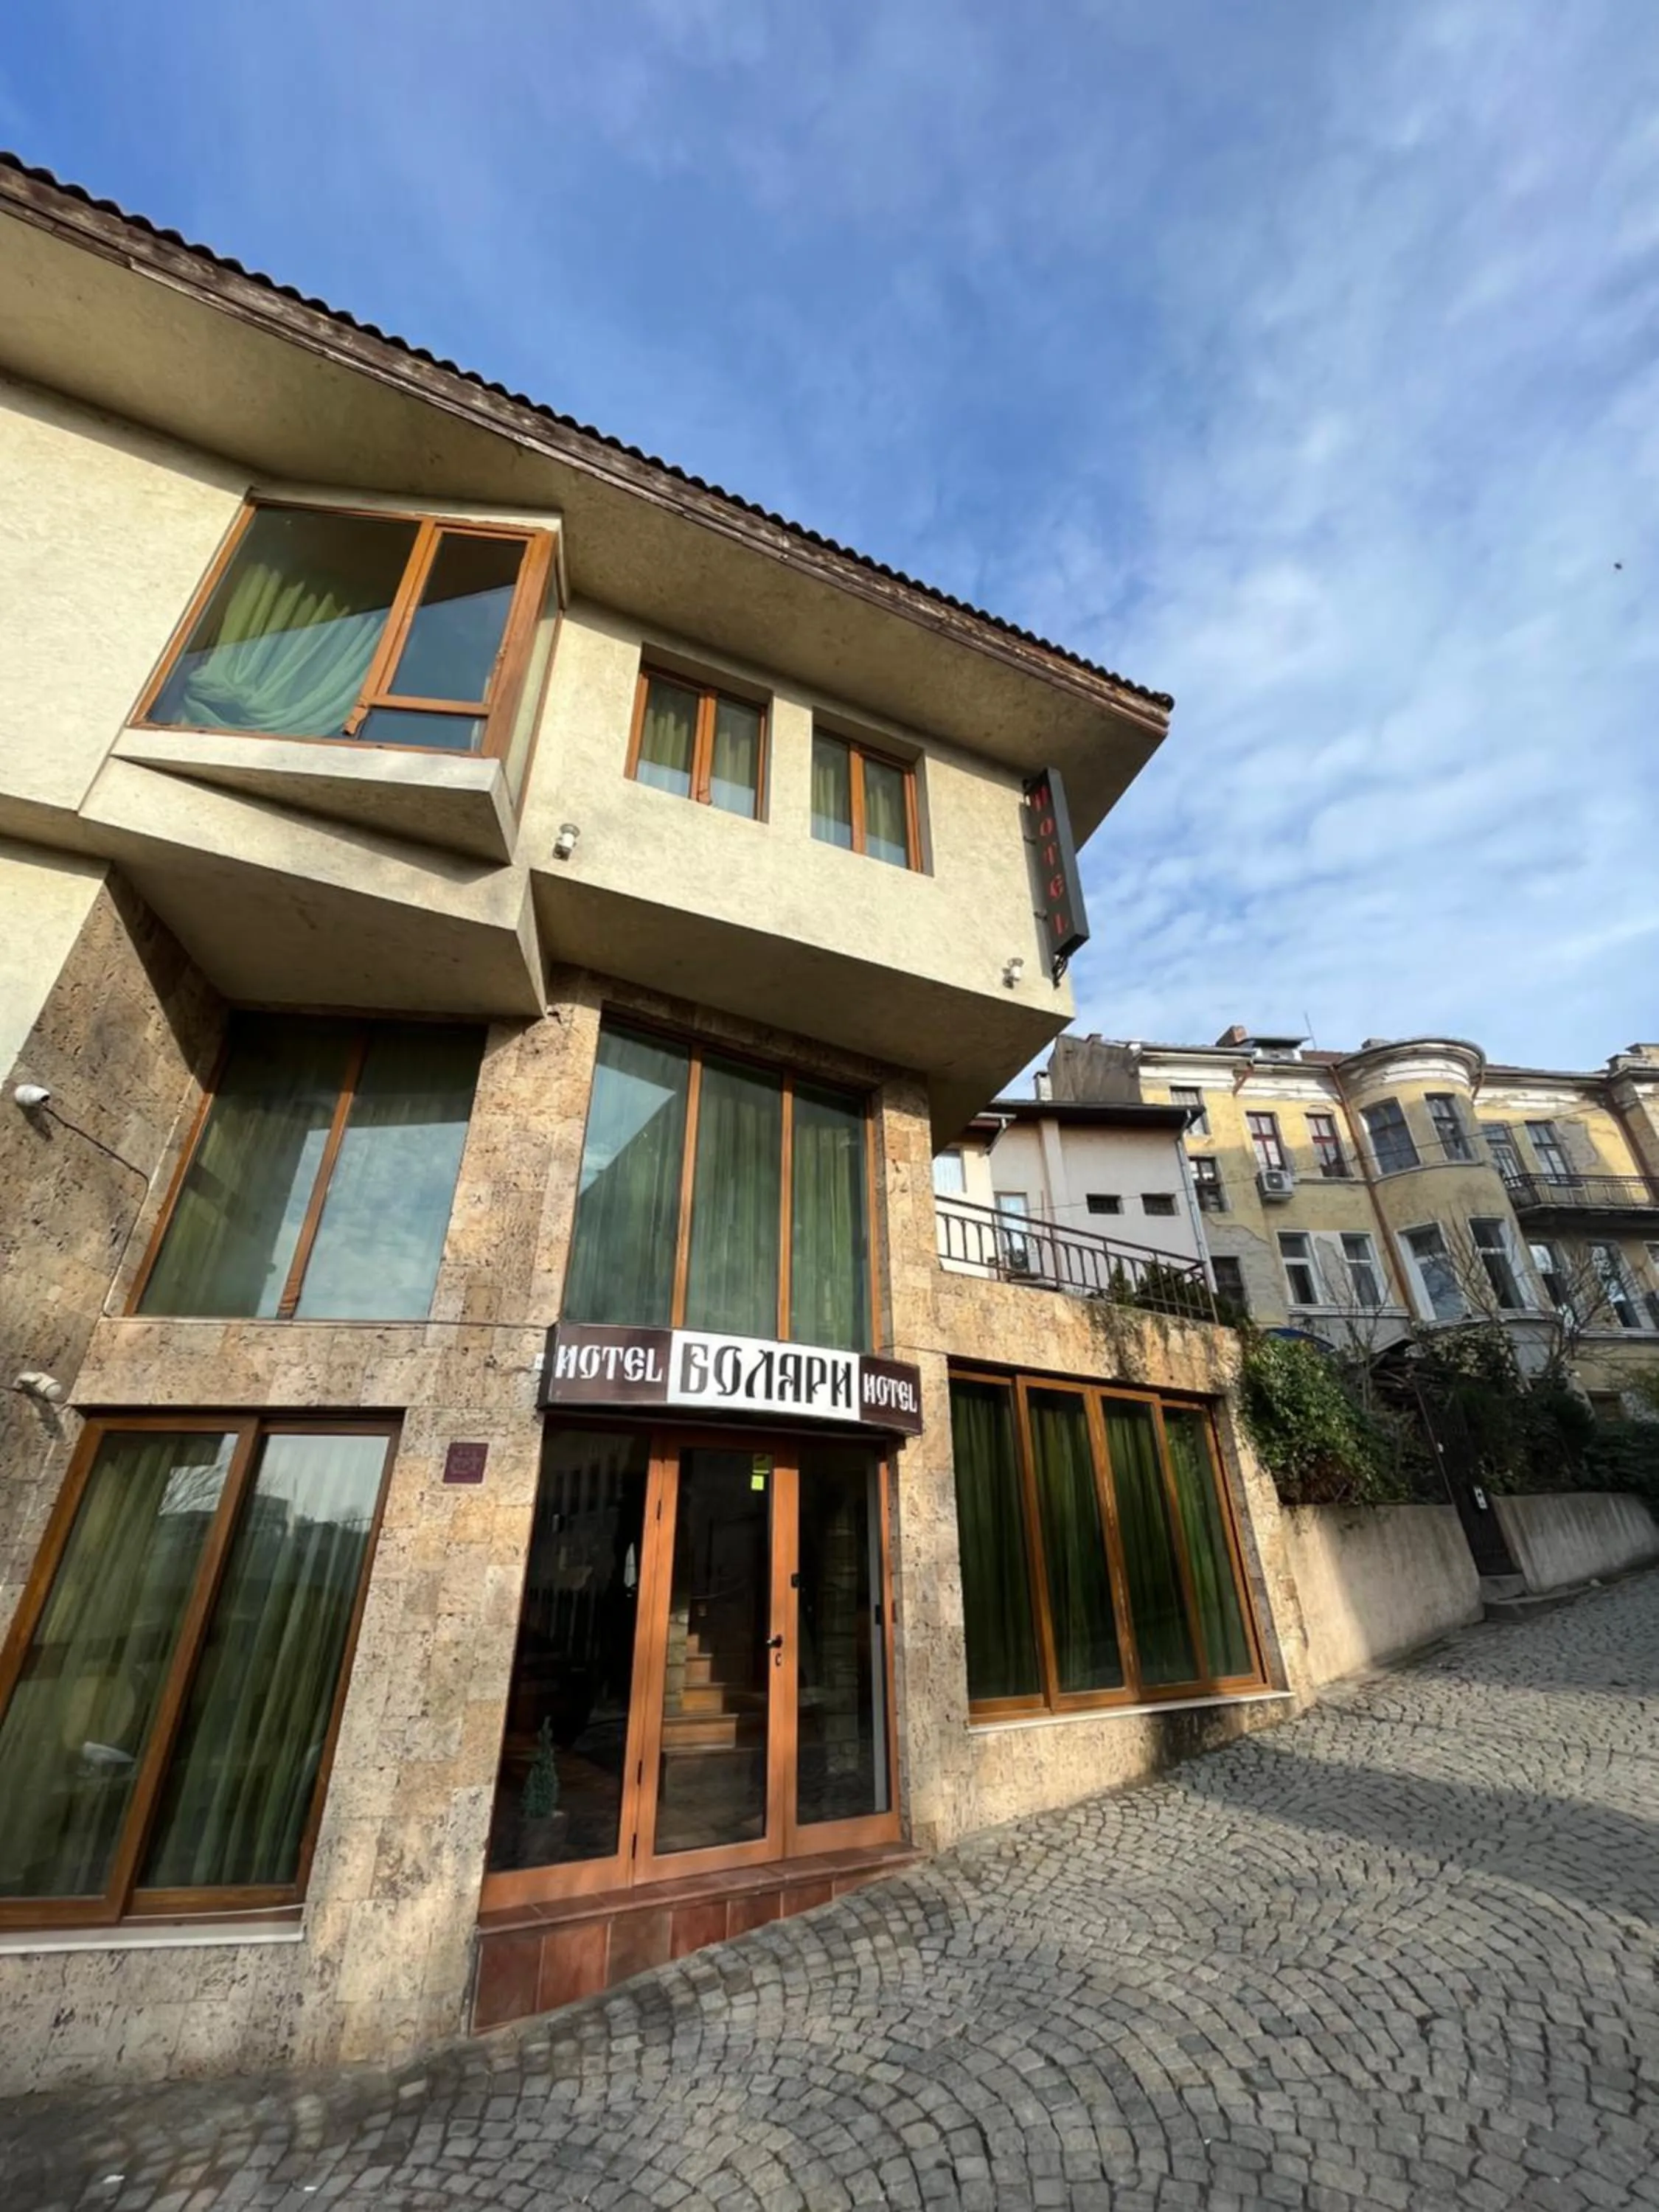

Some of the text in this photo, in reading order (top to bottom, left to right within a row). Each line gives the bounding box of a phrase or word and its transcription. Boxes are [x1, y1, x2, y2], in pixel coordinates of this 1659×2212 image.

[554, 1345, 663, 1382] HOTEL
[679, 1343, 852, 1408] БОЛЯРИ
[863, 1372, 917, 1413] HOTEL
